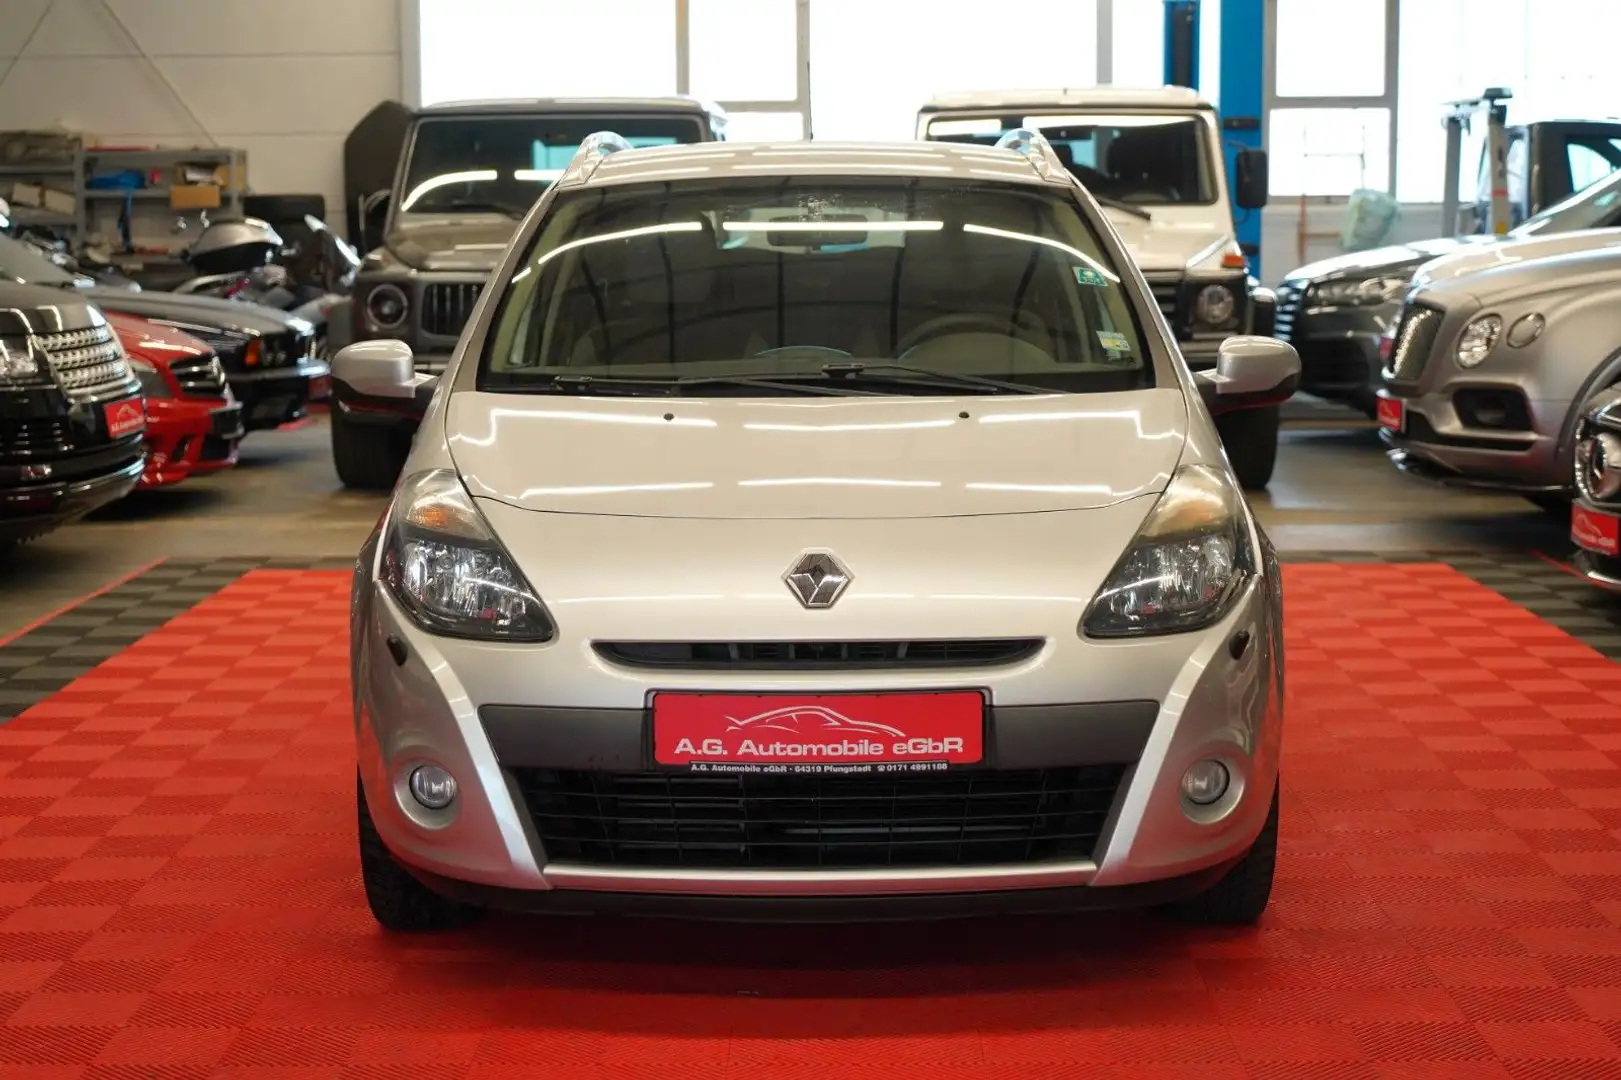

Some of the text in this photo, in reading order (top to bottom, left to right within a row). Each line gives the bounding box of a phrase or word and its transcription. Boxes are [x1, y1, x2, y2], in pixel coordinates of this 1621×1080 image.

[673, 737, 964, 756] A.G. Automobile eGbR
[691, 764, 709, 772] A.G.
[711, 764, 761, 773] Automobile
[887, 763, 907, 772] 0171
